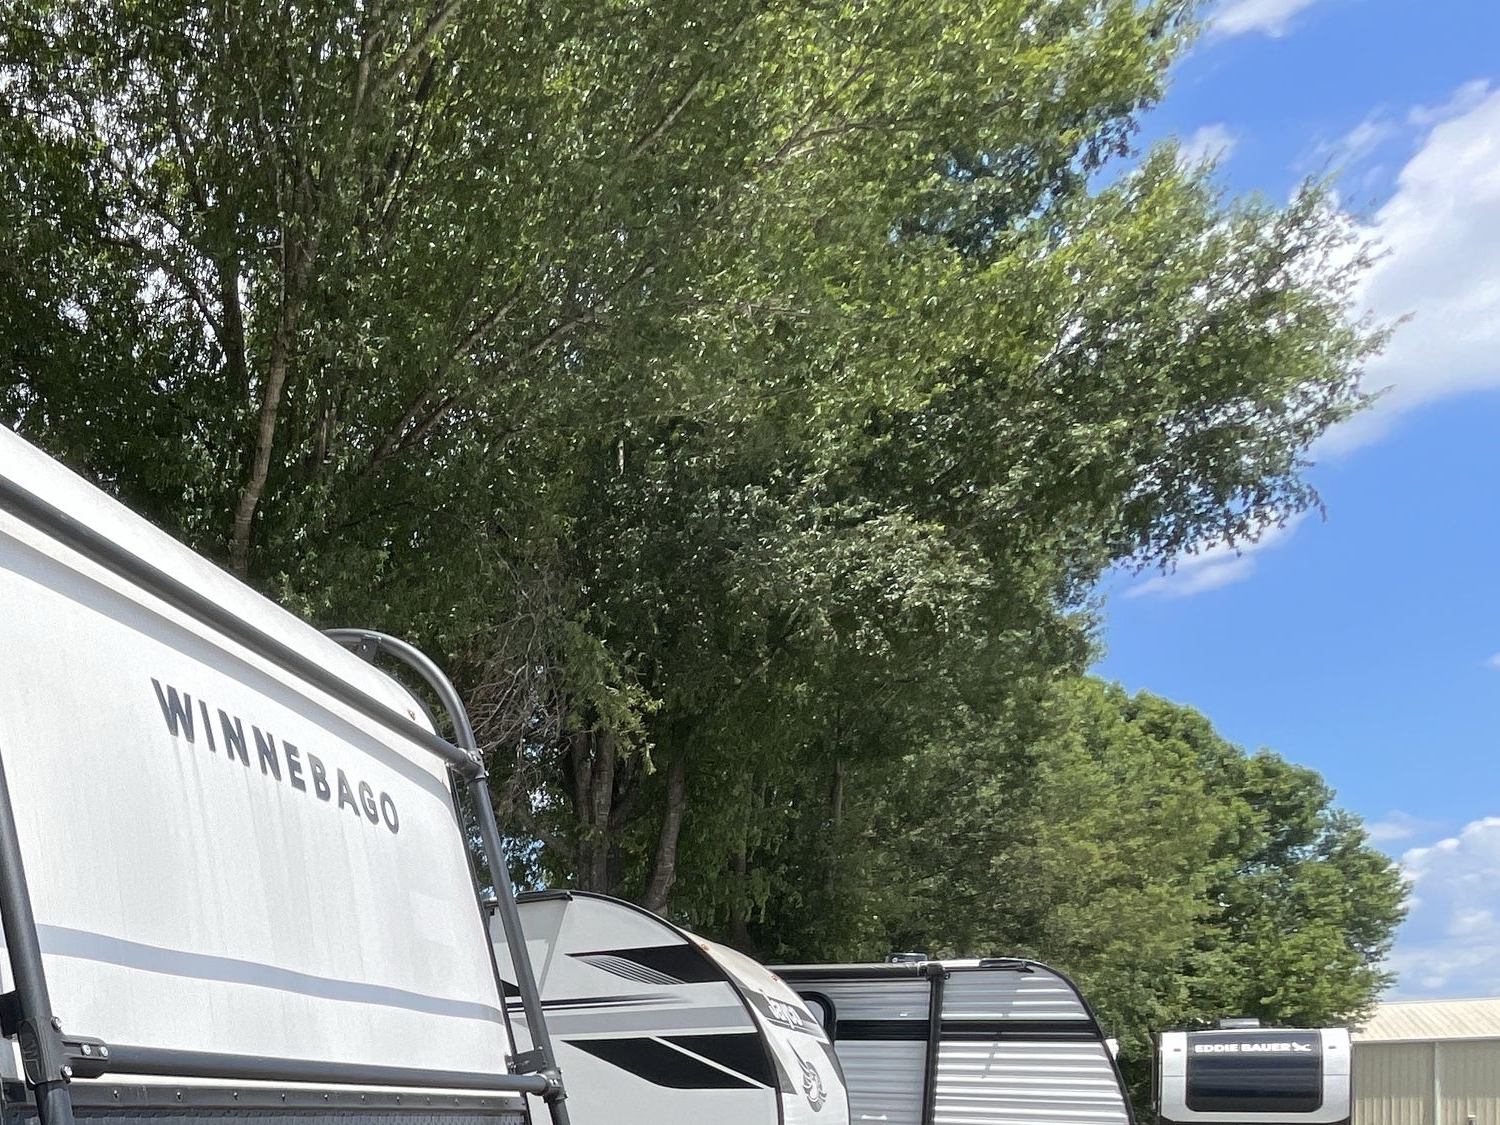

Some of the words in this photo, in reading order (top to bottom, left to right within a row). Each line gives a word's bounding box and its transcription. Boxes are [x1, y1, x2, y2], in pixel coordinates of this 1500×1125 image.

[150, 676, 400, 834] WINNEBAGO
[1194, 1043, 1239, 1053] EDDIE
[1240, 1043, 1291, 1052] BAUER
